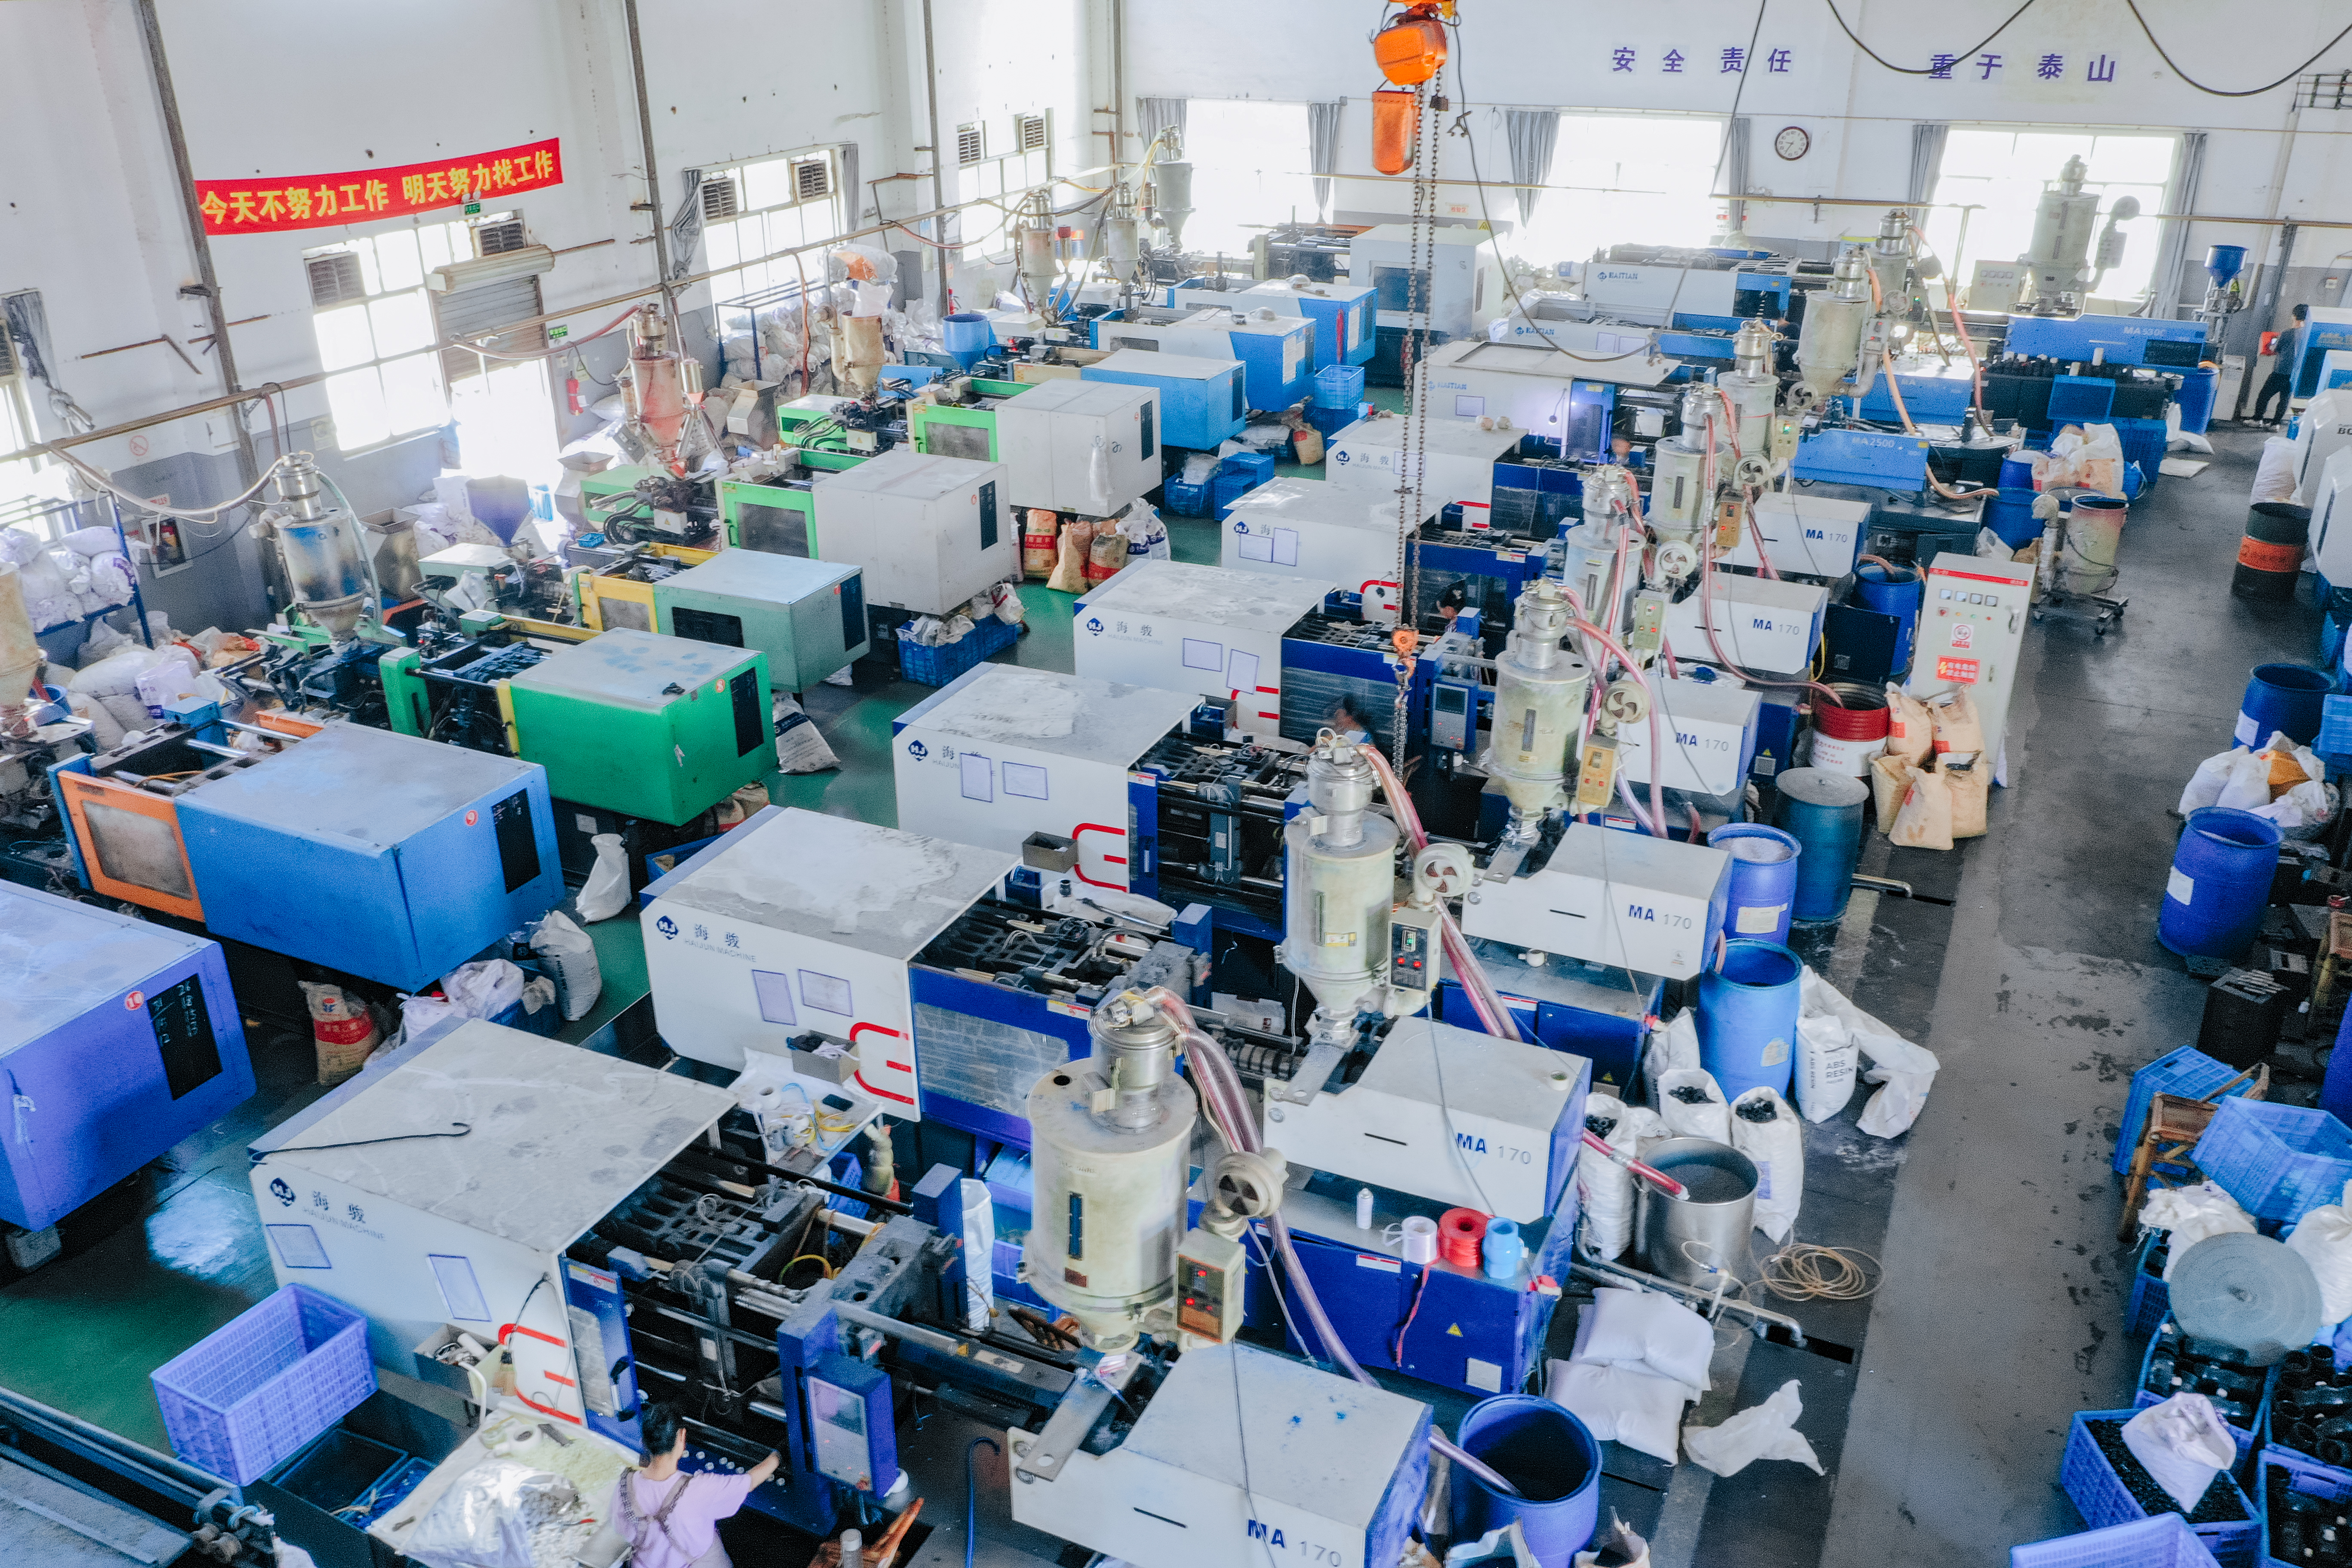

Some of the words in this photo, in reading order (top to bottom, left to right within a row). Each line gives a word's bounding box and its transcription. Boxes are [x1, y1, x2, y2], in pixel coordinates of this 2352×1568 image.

[1613, 47, 1791, 73] 安全责任
[1929, 54, 2116, 82] 重于泰山
[201, 179, 389, 224] 今天不努力工作
[402, 150, 554, 205] 明天努力找工作
[1608, 272, 1638, 280] HAITIAN
[1806, 529, 1823, 540] MA
[1829, 533, 1848, 543] 170
[1117, 621, 1153, 637] 海骏
[1753, 619, 1773, 631] MA
[1779, 624, 1800, 635] 170
[1676, 732, 1697, 746] MA
[1705, 739, 1729, 752] 170
[1629, 904, 1655, 922] MA
[1663, 914, 1692, 930] 170
[694, 924, 740, 949] 海骏
[684, 938, 715, 951] HAIJUN
[716, 946, 756, 962] MACHINE
[127, 993, 144, 1008] 10
[1827, 1060, 1846, 1069] ABS
[1457, 1132, 1488, 1154] MA
[1498, 1145, 1531, 1164] 170
[1247, 1519, 1287, 1550] MA
[1298, 1540, 1342, 1567] 170
